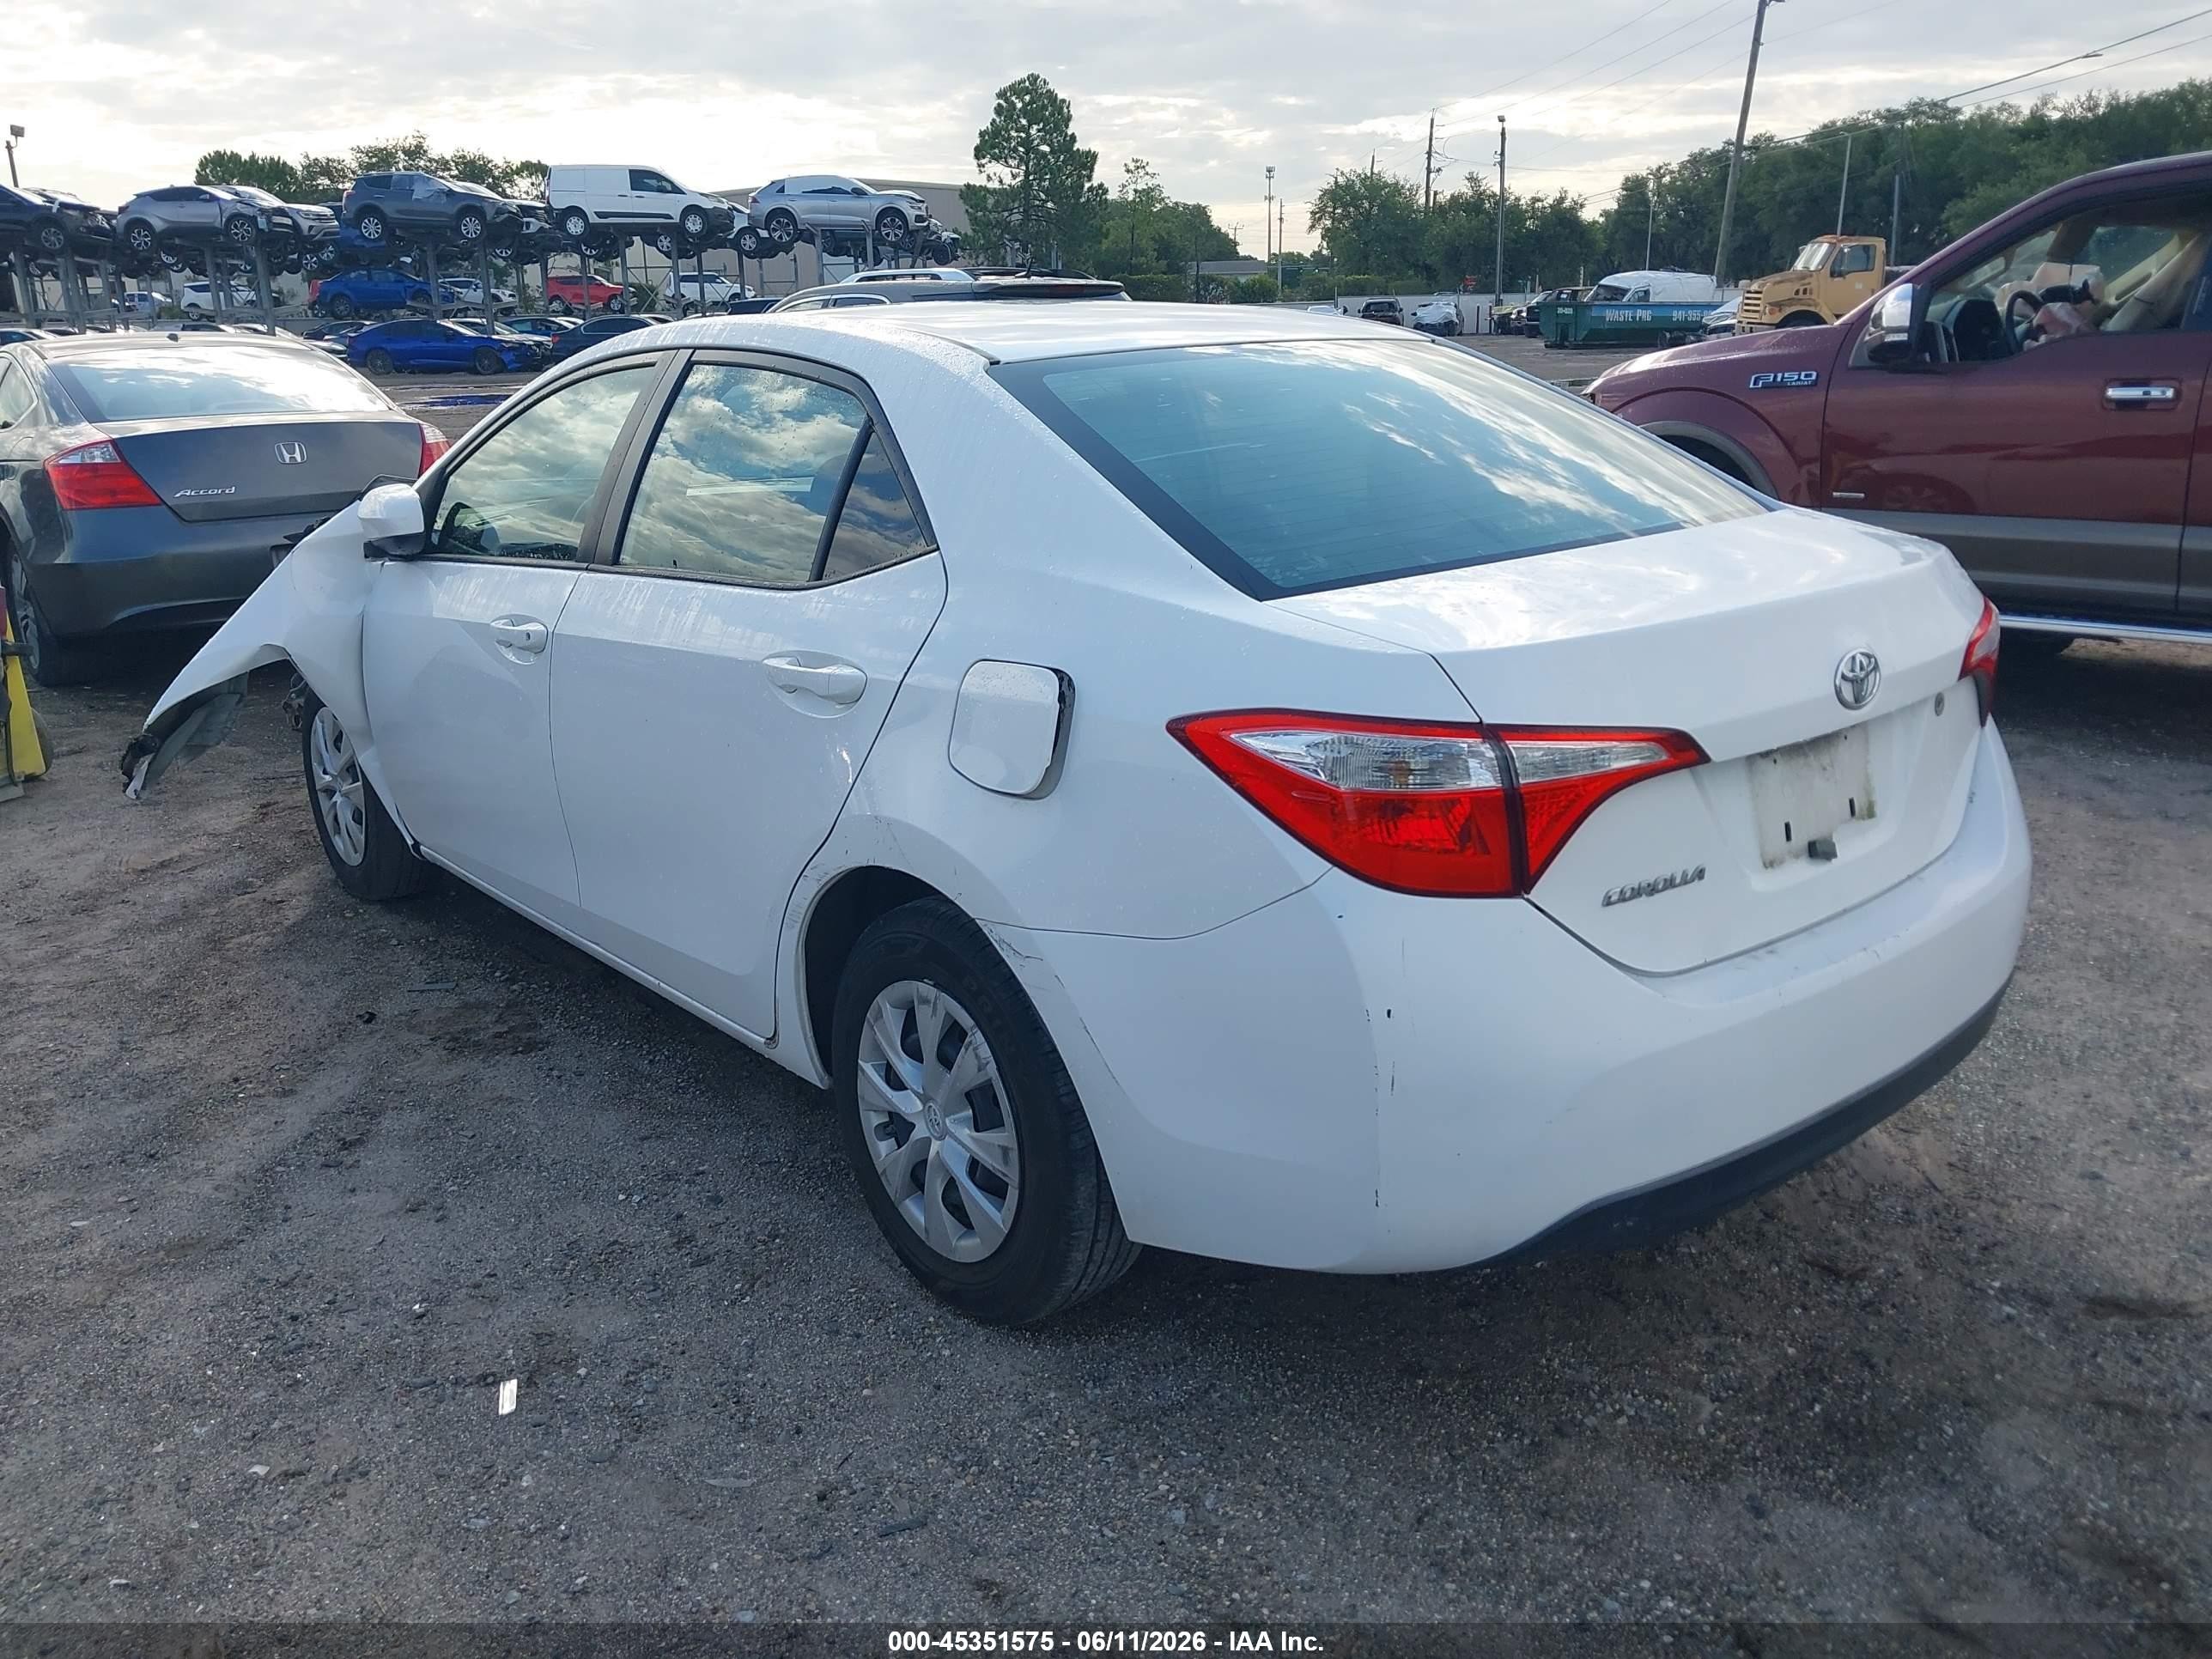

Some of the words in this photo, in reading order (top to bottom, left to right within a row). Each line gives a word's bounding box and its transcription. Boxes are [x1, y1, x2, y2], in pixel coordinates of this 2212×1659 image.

[1606, 309, 1633, 321] WASTE
[173, 486, 236, 498] Accord
[1601, 864, 1706, 907] COROLLA
